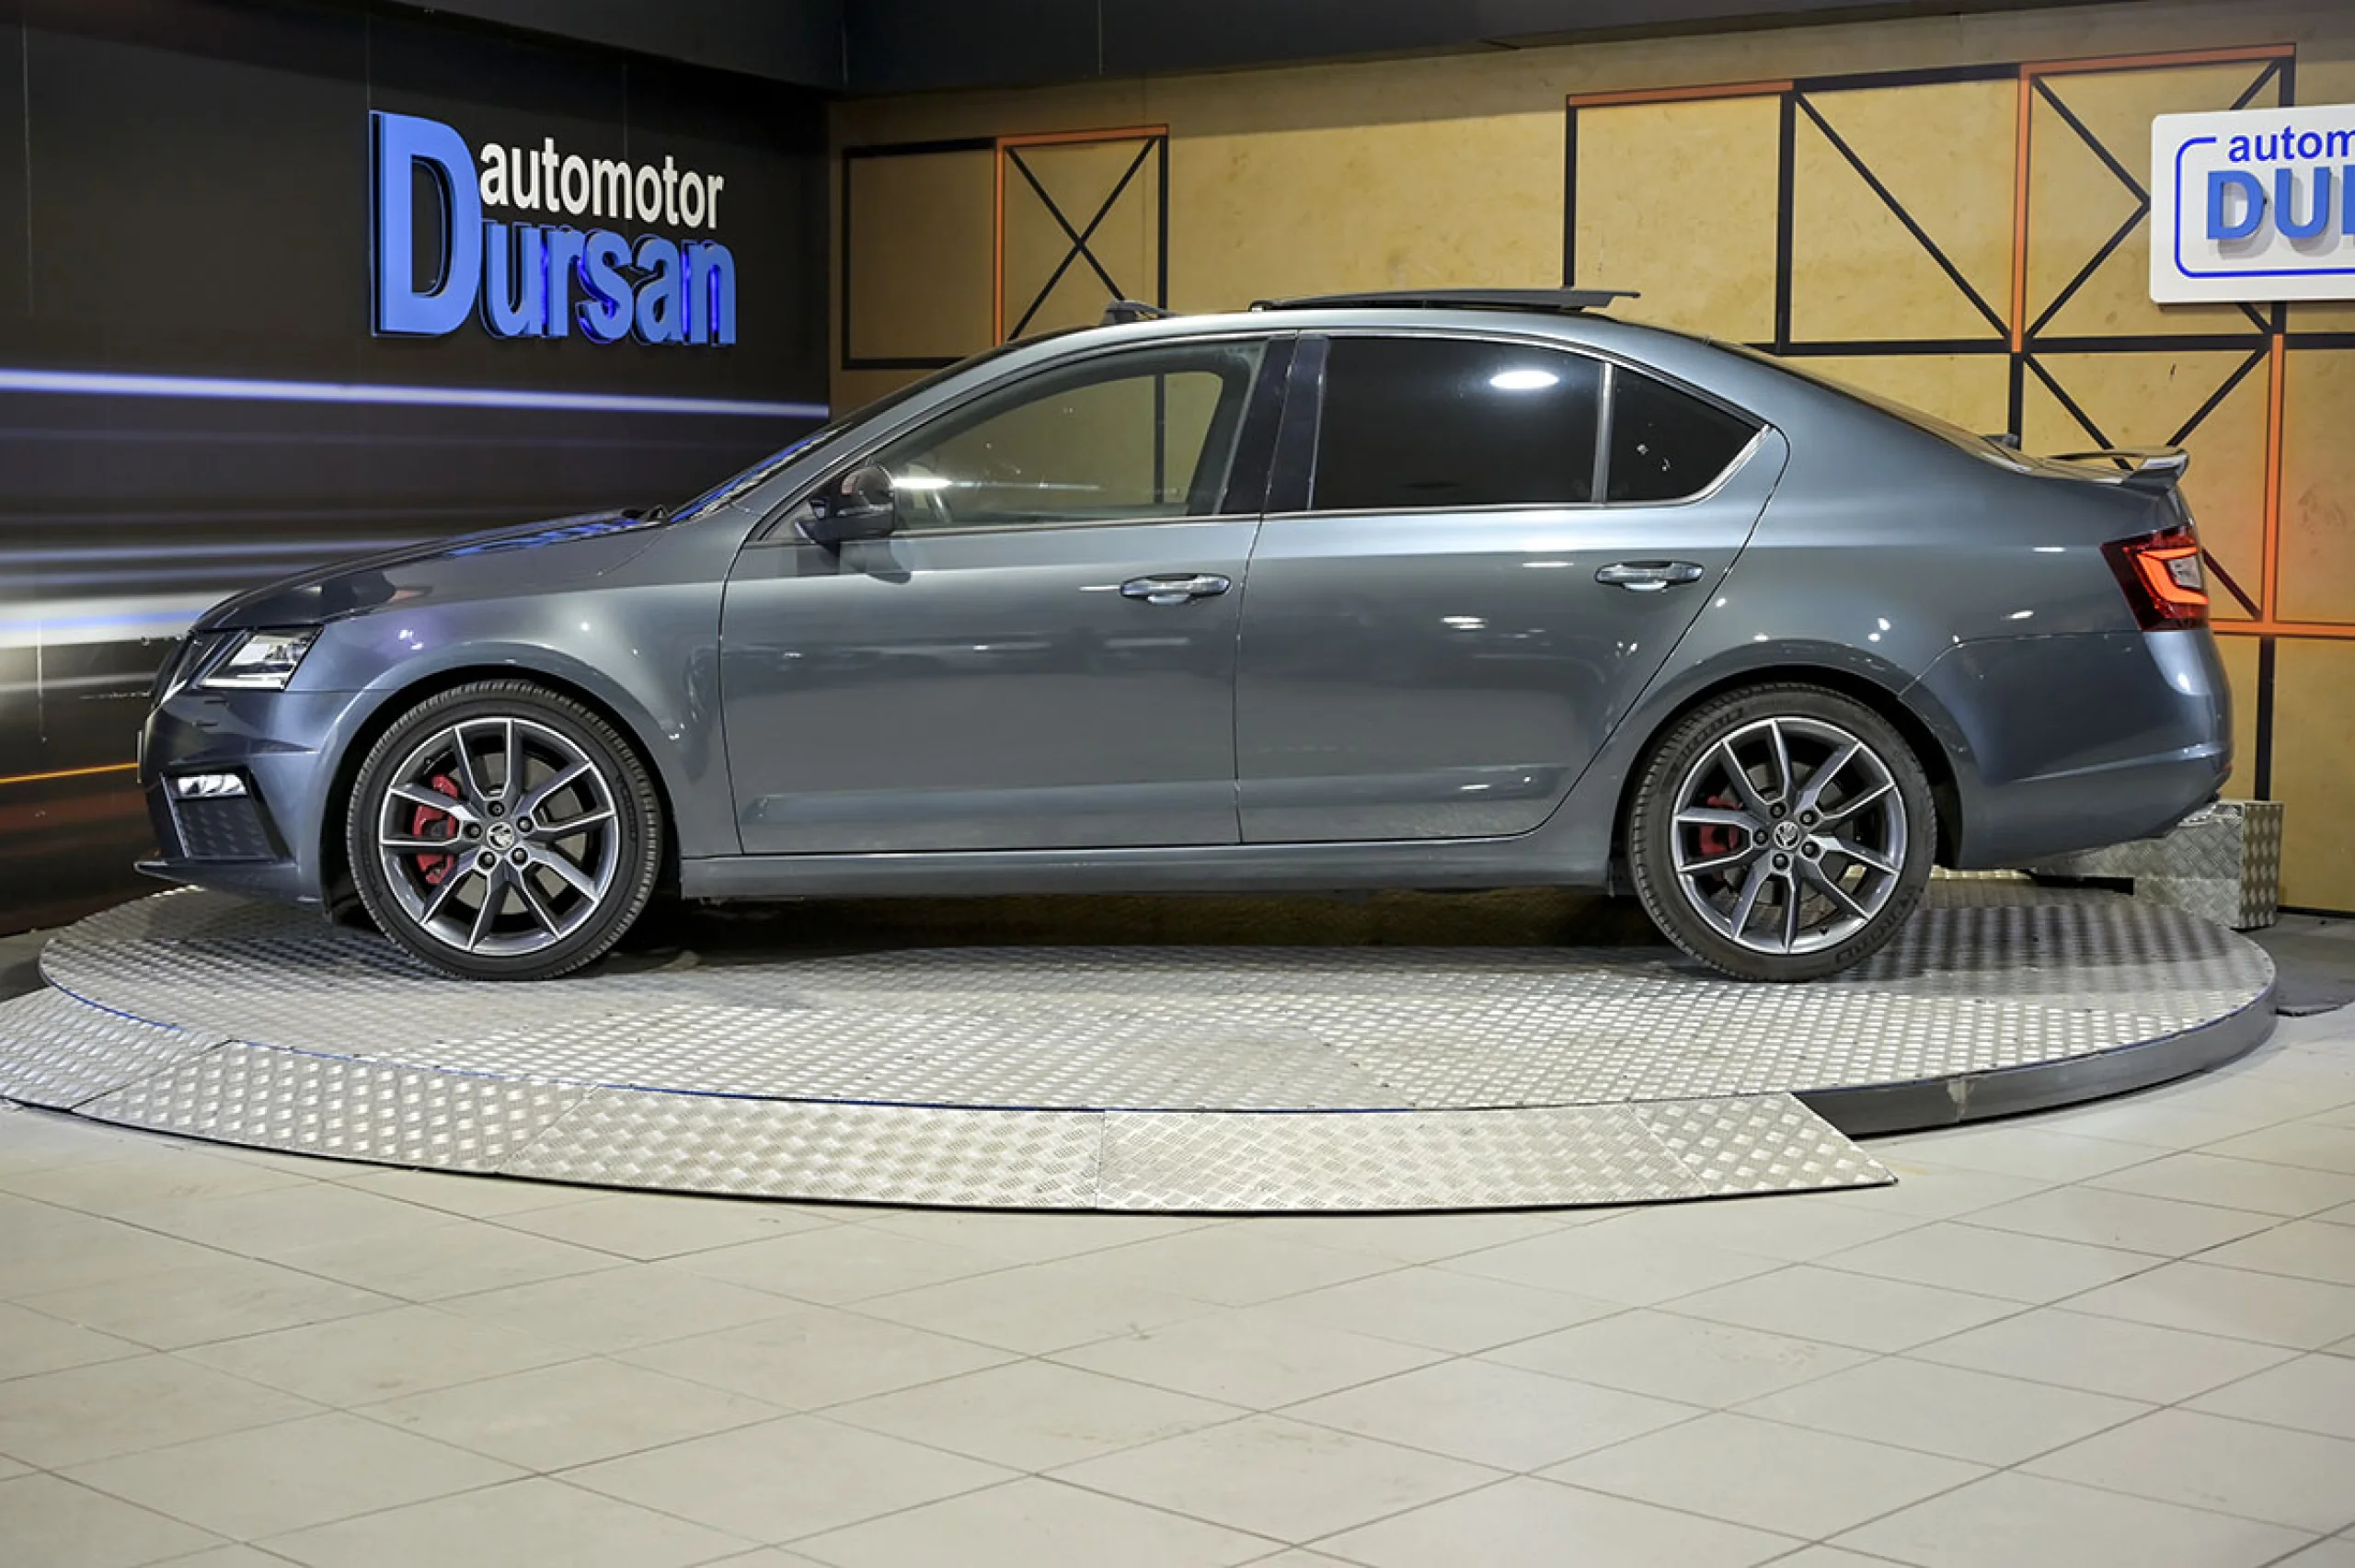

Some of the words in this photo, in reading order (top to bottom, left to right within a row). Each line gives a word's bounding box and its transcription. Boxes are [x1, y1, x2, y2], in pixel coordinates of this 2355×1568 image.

[369, 109, 737, 348] Dursan
[480, 137, 724, 229] automotor
[2206, 164, 2355, 239] DU
